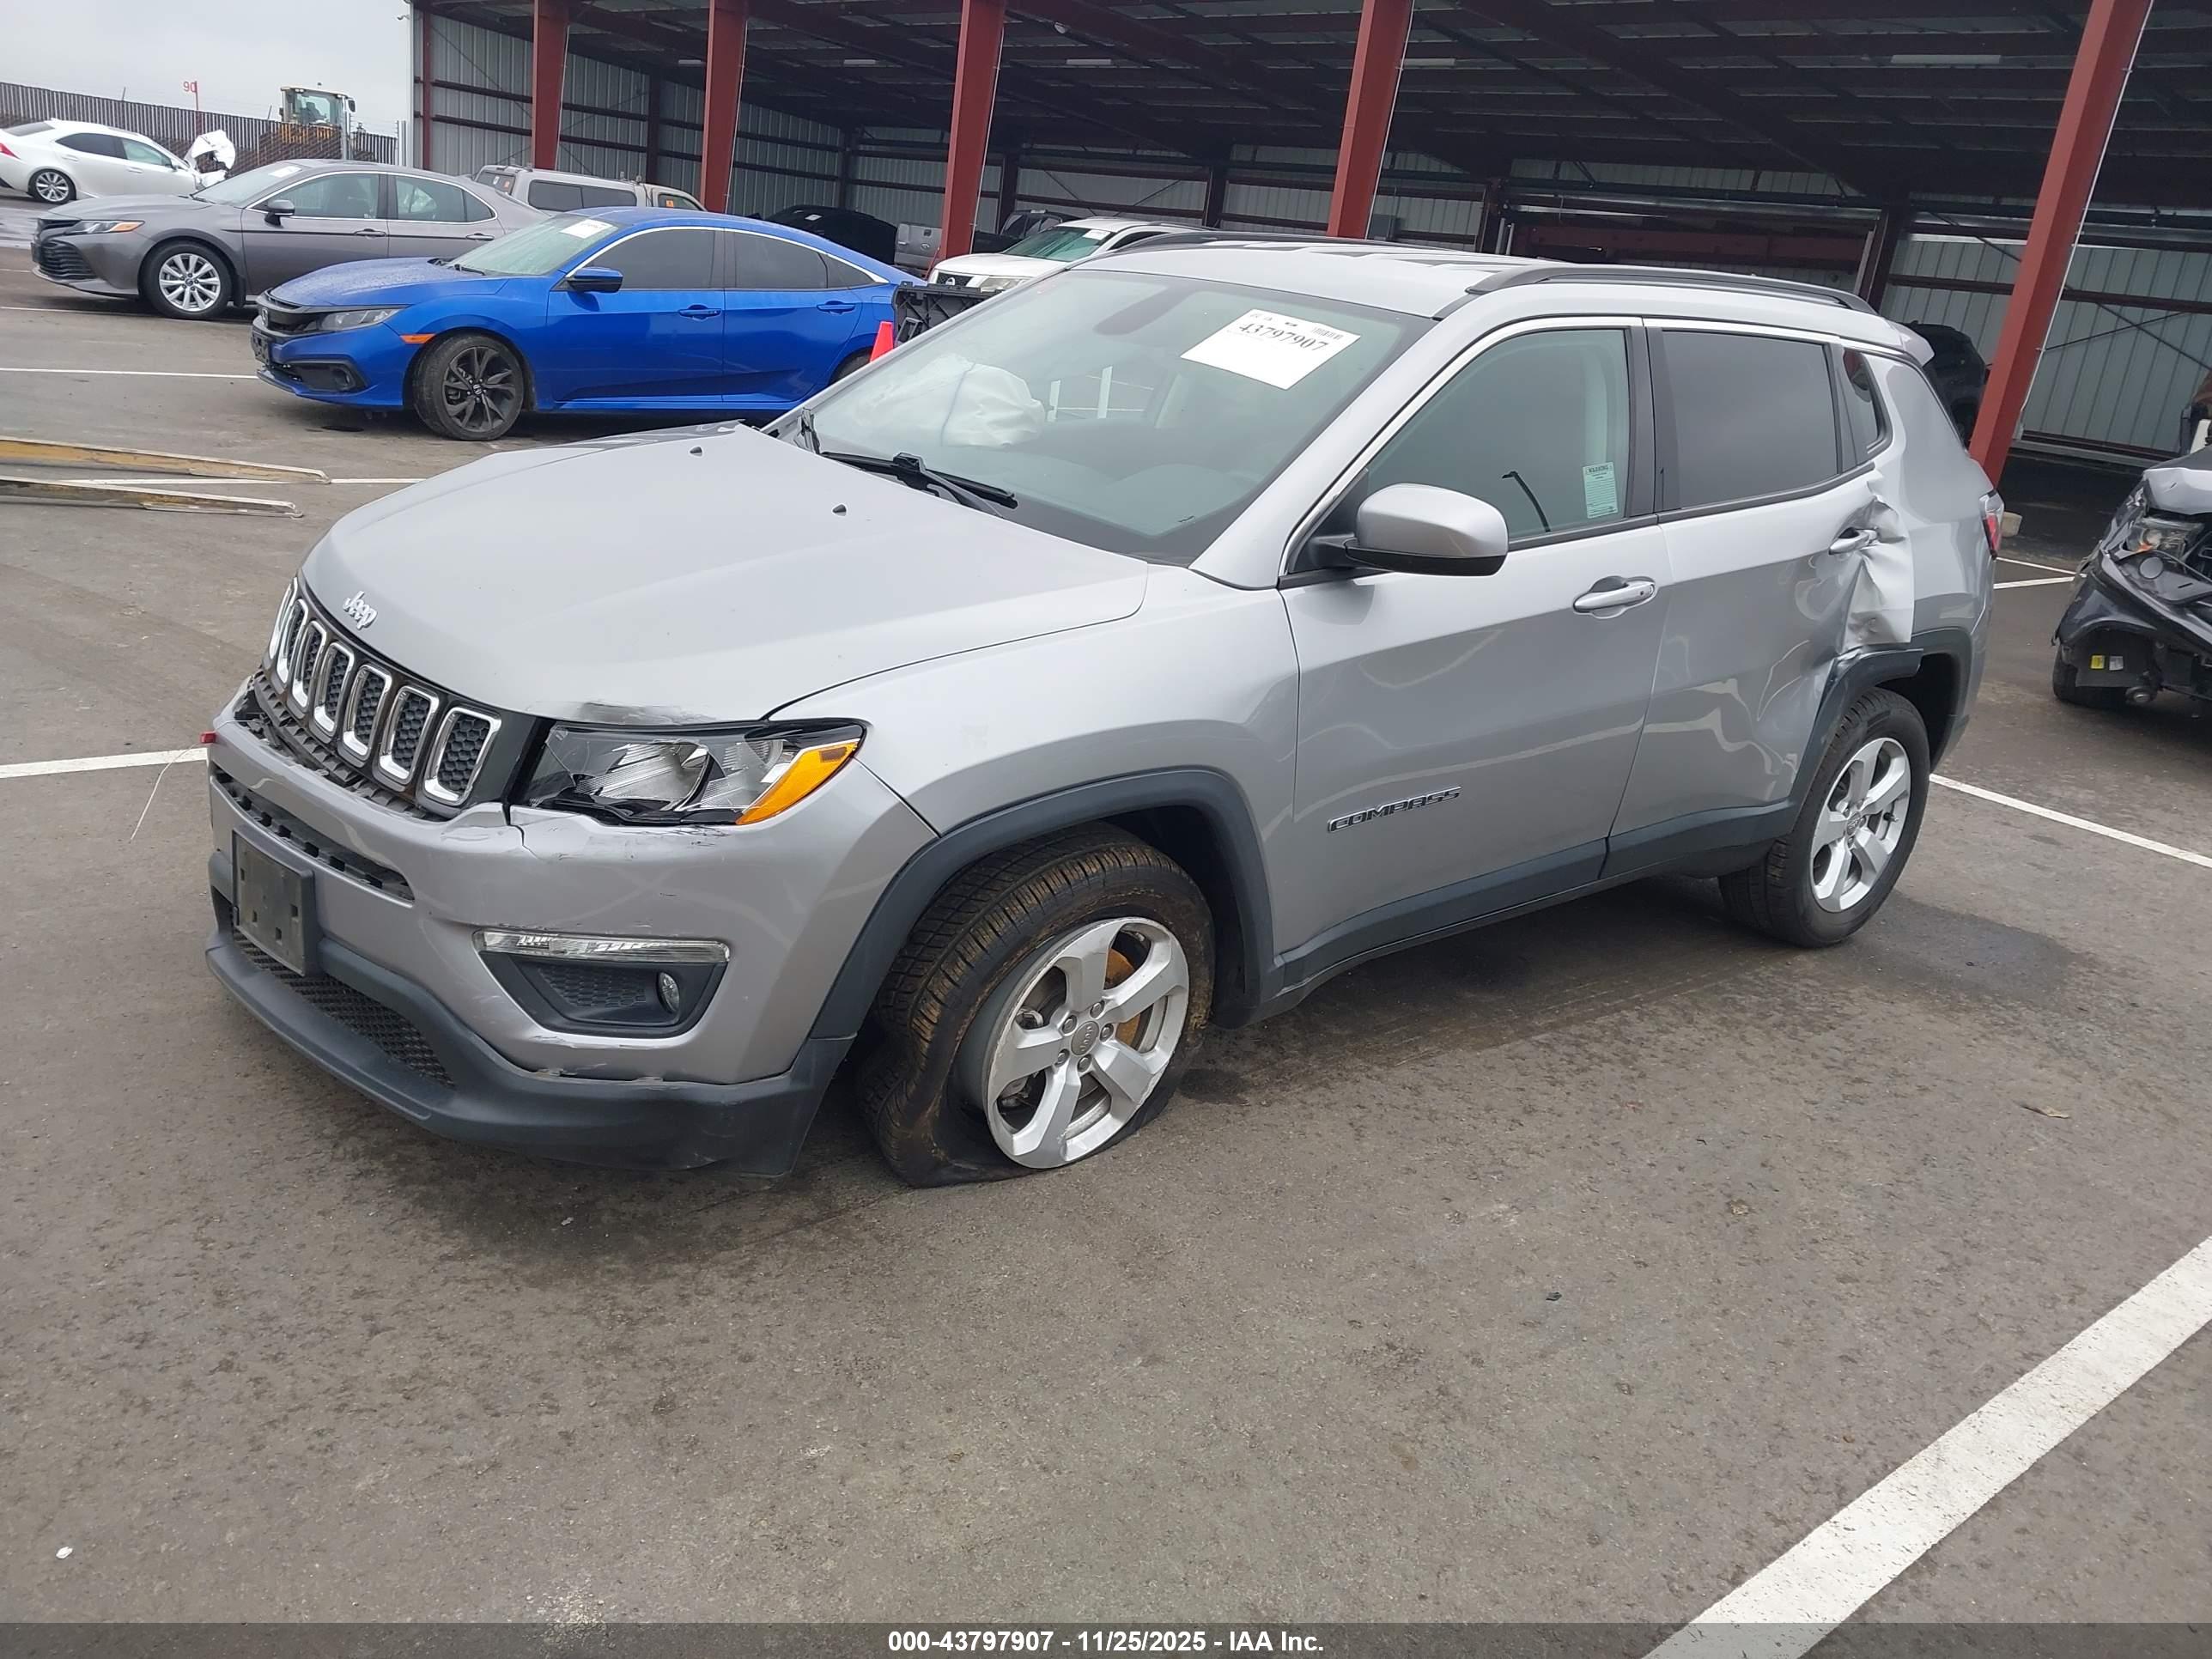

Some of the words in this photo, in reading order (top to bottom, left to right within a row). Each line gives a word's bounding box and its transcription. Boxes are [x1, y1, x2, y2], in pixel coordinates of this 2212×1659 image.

[1239, 323, 1328, 350] 43797907
[343, 590, 378, 630] Jeep
[1327, 786, 1462, 832] COMPASS
